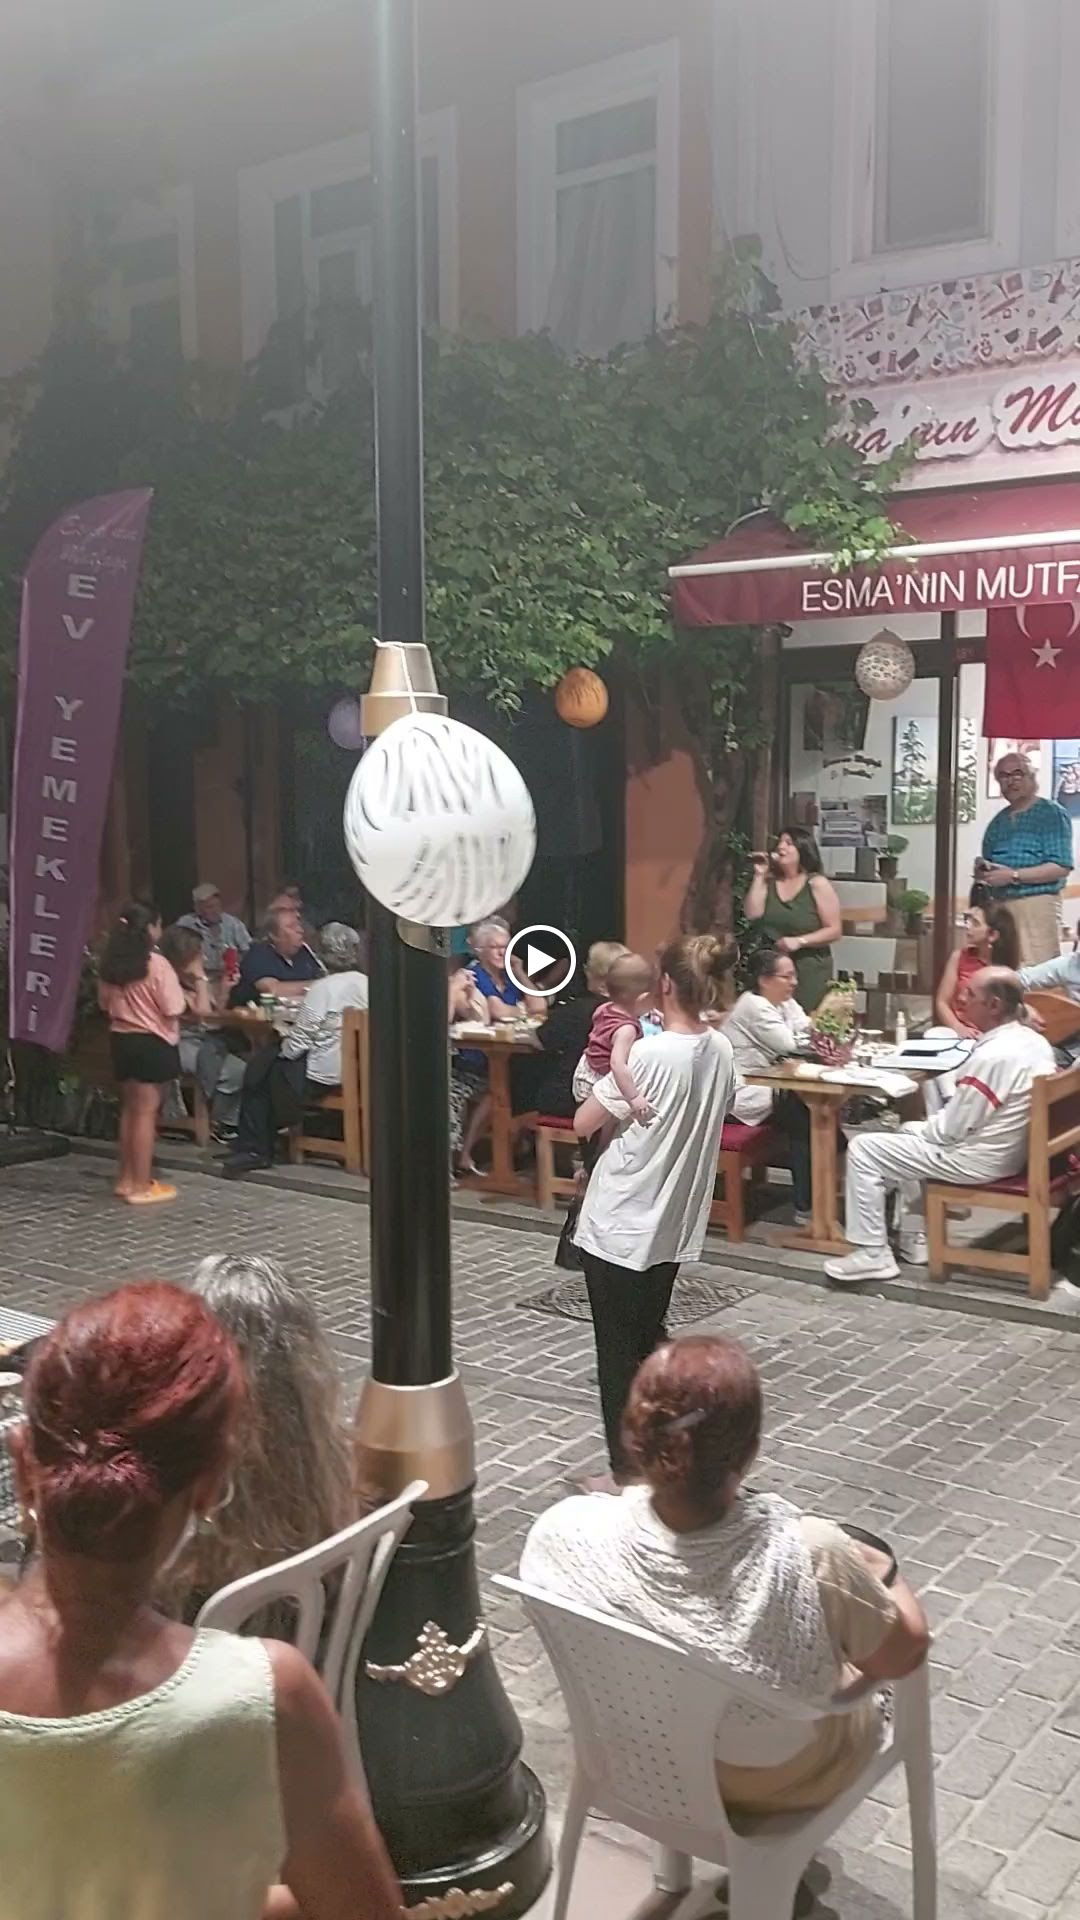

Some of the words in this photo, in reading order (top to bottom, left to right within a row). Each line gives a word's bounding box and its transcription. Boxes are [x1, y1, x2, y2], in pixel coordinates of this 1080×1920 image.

[62, 573, 97, 640] EV
[802, 570, 965, 612] ESMA'NIN
[976, 560, 1080, 600] MUTF
[26, 695, 84, 1032] YEMEKLERİ
